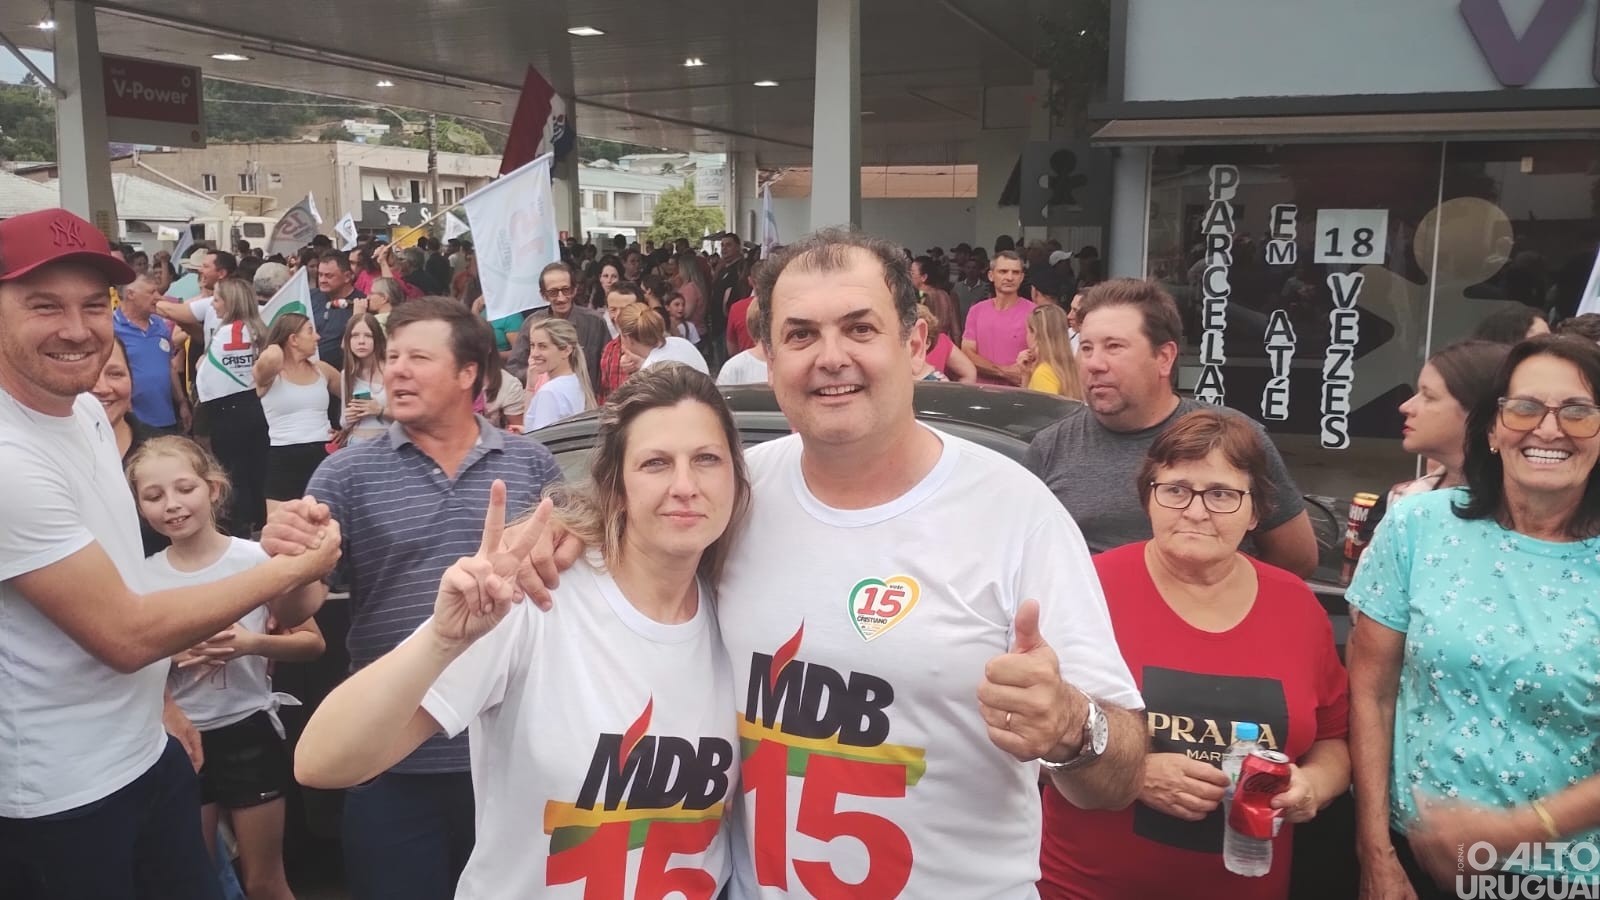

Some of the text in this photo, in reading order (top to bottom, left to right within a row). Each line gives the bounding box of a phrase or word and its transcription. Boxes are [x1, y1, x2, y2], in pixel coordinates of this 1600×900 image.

[1459, 0, 1600, 88] V
[111, 78, 189, 105] V-Power
[49, 219, 86, 248] NY
[1324, 227, 1375, 258] 18
[1264, 205, 1297, 420] EM ATÉ
[1323, 275, 1363, 448] VEZES
[856, 616, 888, 625] CRISTIANO
[857, 587, 906, 618] 15
[745, 651, 895, 747] MDB
[575, 733, 733, 811] MDB
[739, 738, 914, 900] 15
